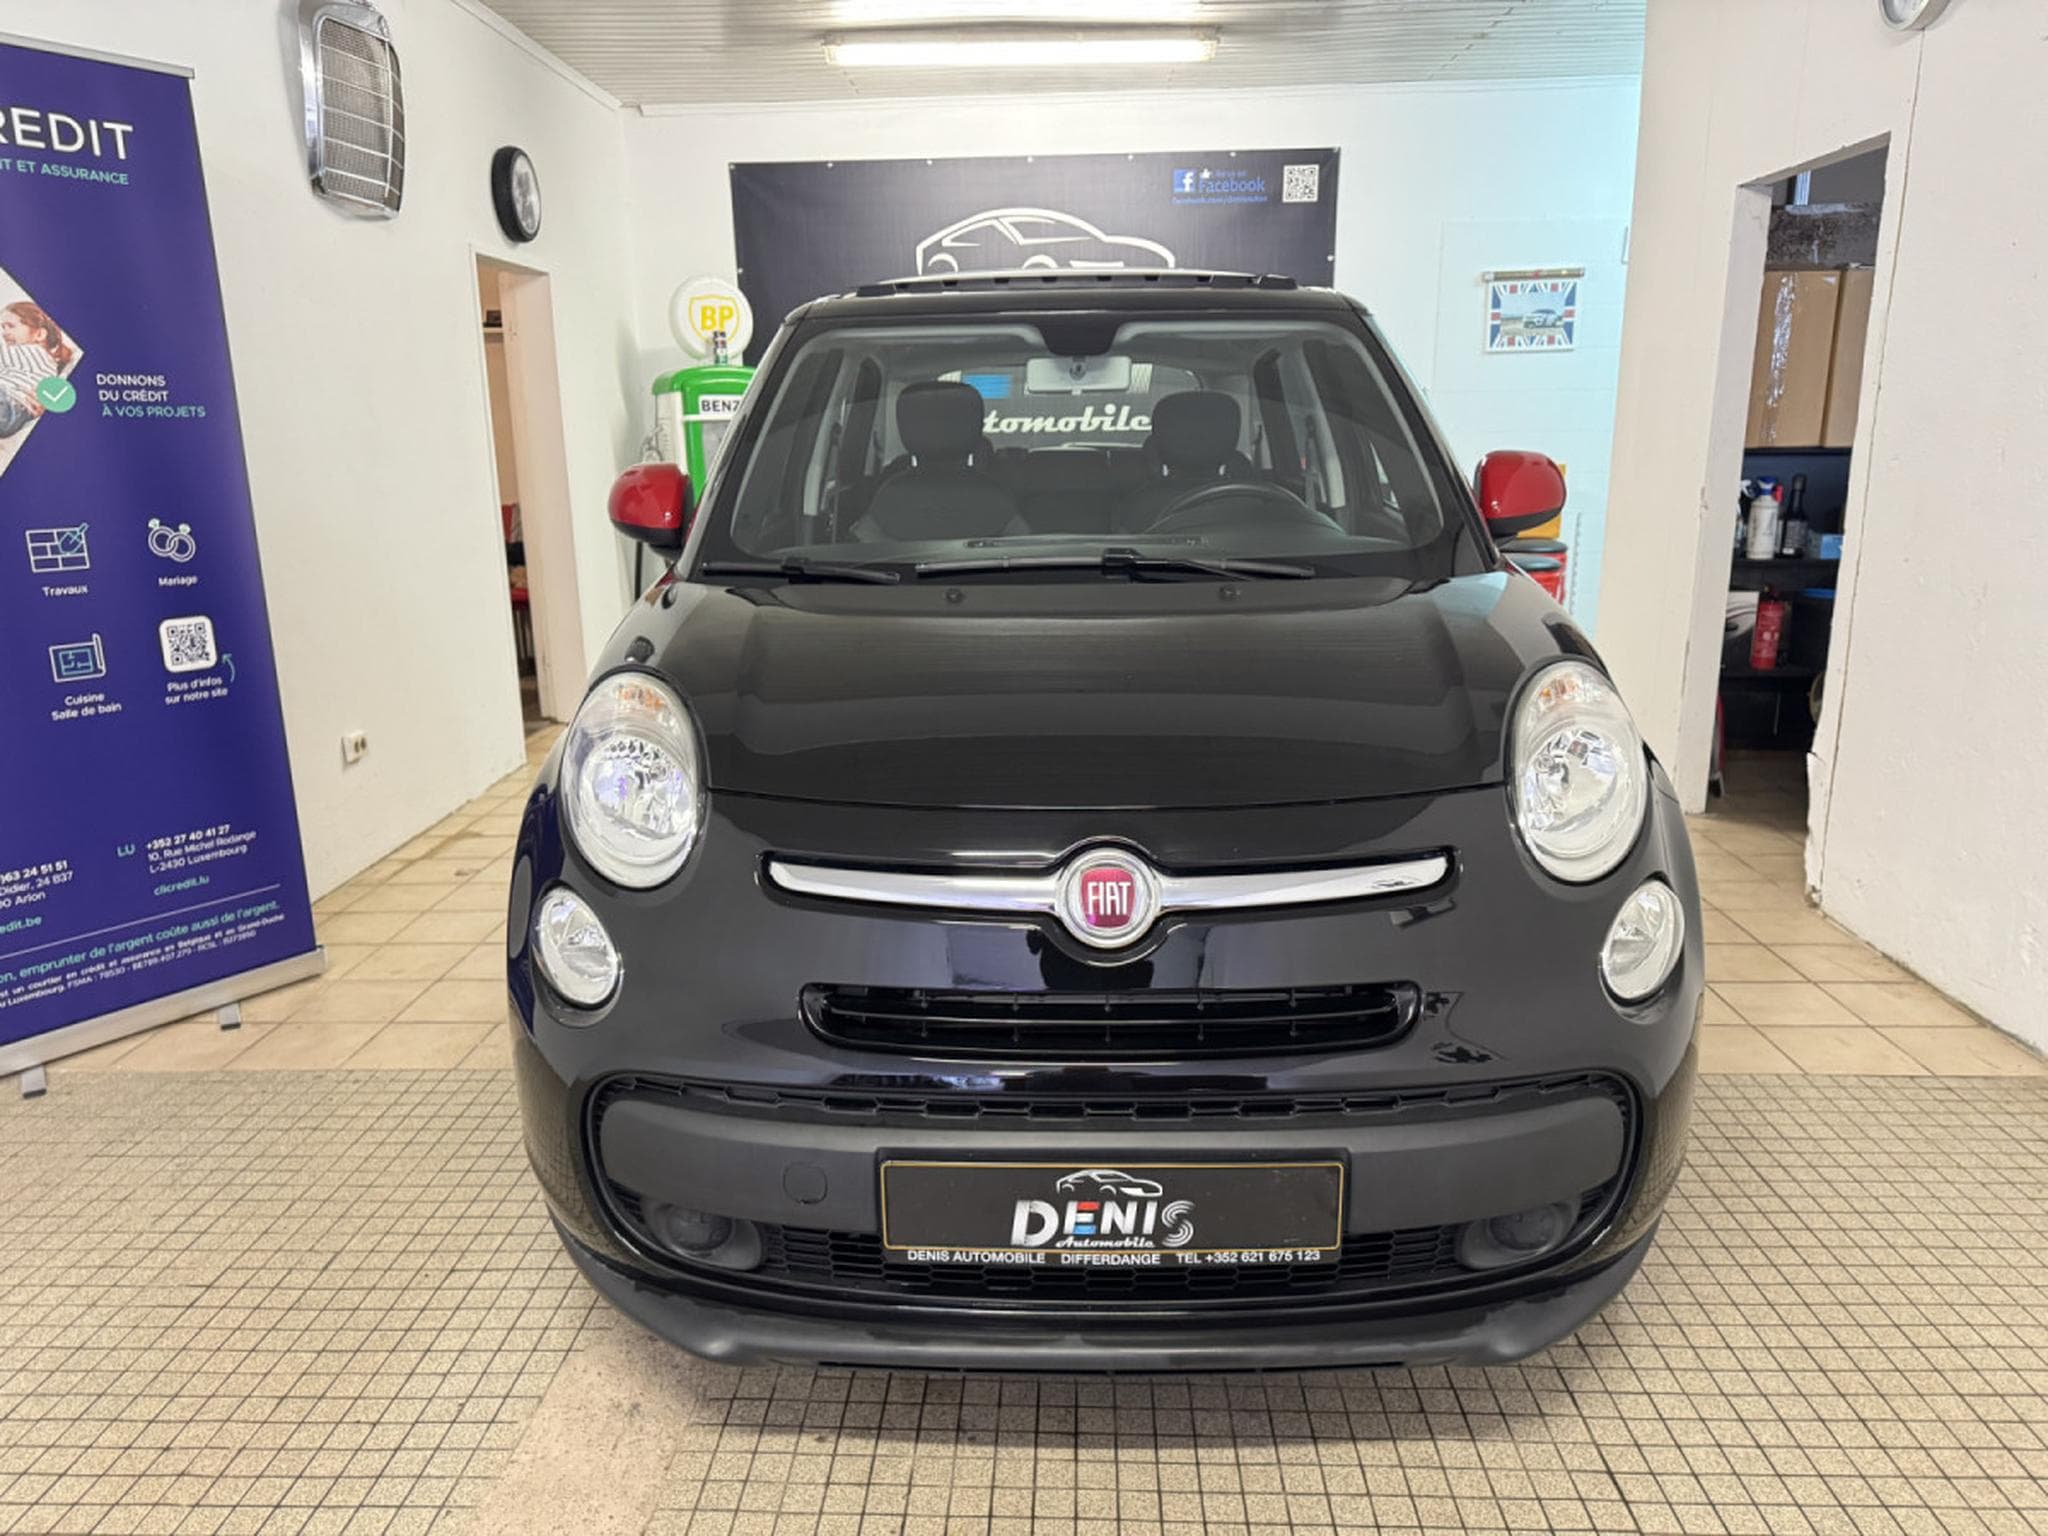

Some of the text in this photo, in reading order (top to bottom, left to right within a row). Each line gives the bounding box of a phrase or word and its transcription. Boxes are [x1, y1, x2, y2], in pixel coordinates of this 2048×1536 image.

[0, 107, 133, 160] EDIT
[17, 160, 36, 173] ET
[41, 163, 129, 185] ASSURANCE
[701, 305, 734, 331] BP
[96, 373, 166, 387] DONNONS
[99, 388, 168, 402] DU CRÉDIT
[102, 403, 206, 417] À VOS PROJETS
[982, 403, 1153, 433] tomobile
[158, 575, 198, 587] Mariage
[42, 585, 88, 597] Travaux
[167, 676, 222, 692] Plus d'infos
[64, 692, 105, 706] Cuisine
[165, 687, 228, 705] sur notre site
[52, 703, 122, 721] Salle de bain
[147, 838, 171, 851] +352
[173, 833, 186, 845] 27
[189, 830, 203, 841] 40
[205, 827, 216, 838] 41
[163, 847, 183, 859] Rue
[184, 840, 215, 854] Michel
[216, 831, 256, 847] Rodange
[117, 844, 136, 857] LU
[187, 845, 248, 865] Luxembourg
[23, 866, 38, 879] 24
[55, 860, 68, 872] 51
[36, 876, 50, 889] 24
[153, 875, 210, 896] clicredit.lu
[1087, 881, 1131, 915] FIAT
[19, 951, 87, 977] emprunter
[89, 946, 106, 959] de
[107, 932, 153, 954] l'argent
[155, 923, 189, 941] coûte
[191, 917, 219, 932] aussi
[221, 911, 235, 923] de
[28, 975, 62, 991] courtier
[1010, 1199, 1196, 1248] DENIS
[1055, 1235, 1155, 1249] Automobile
[907, 1250, 1321, 1265] DENIS AUTOMOBILE DIFFERDANGE TEL +352 621 675 123
